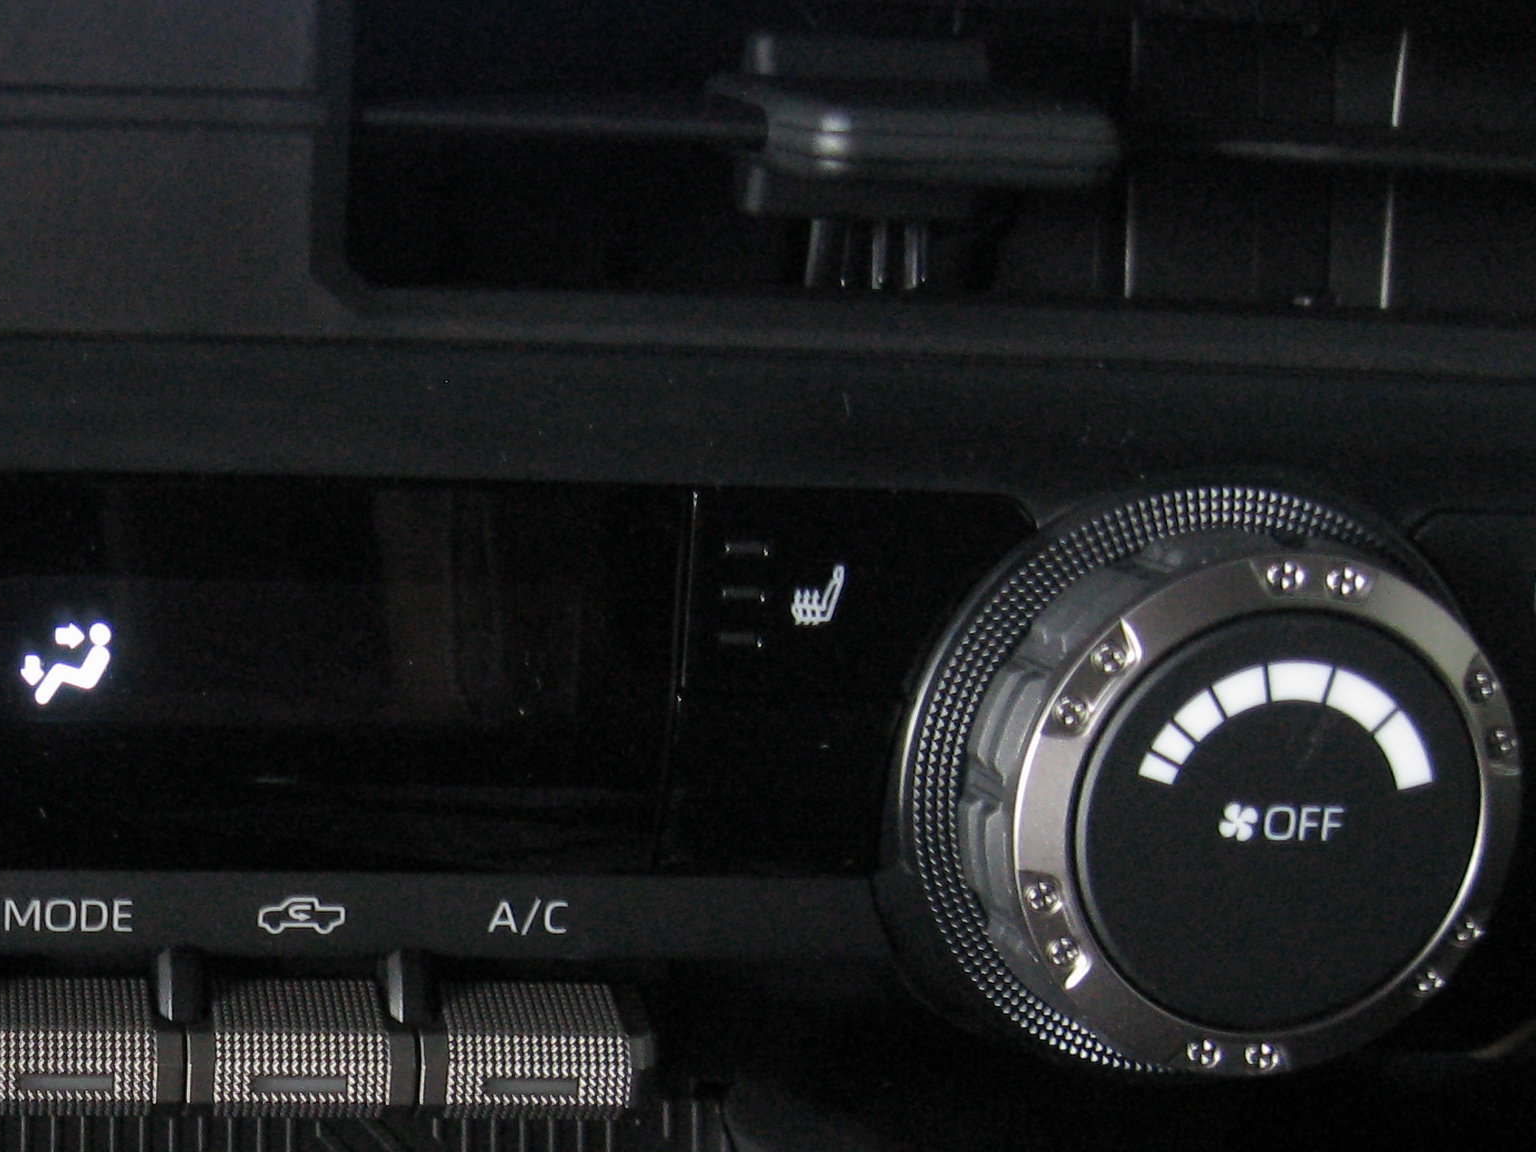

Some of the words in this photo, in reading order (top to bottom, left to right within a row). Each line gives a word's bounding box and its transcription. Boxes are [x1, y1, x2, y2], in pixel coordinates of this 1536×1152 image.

[1263, 805, 1345, 842] OFF
[2, 897, 134, 934] MODE
[487, 896, 570, 936] A/C
